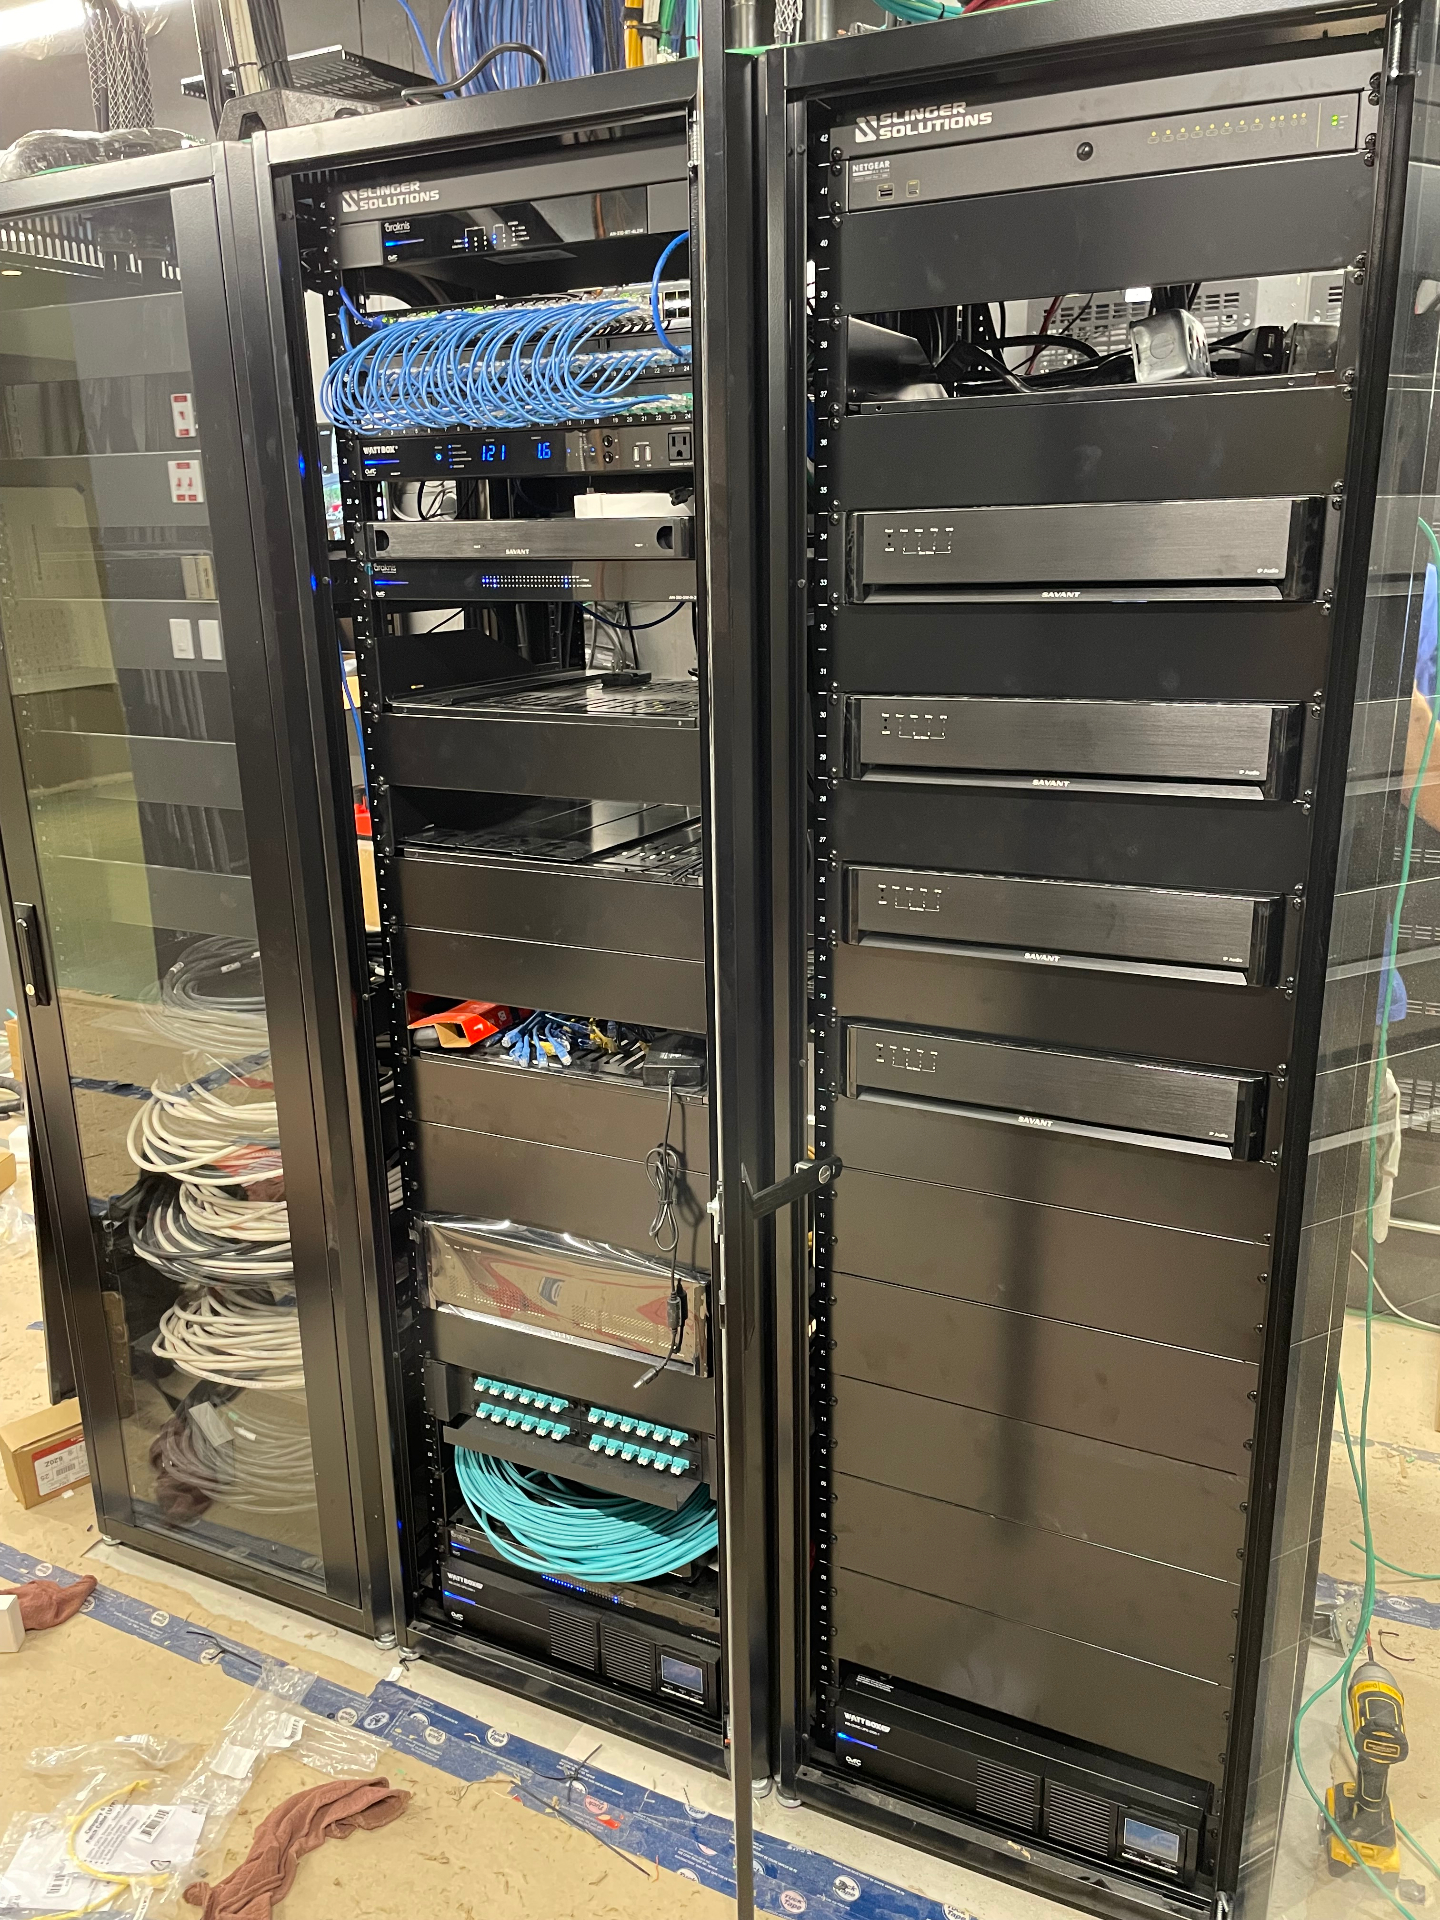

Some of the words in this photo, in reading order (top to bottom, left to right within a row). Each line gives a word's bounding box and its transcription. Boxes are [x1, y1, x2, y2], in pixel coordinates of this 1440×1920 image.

[879, 101, 967, 126] SLINGER
[879, 112, 993, 140] SOLUTIONS
[853, 160, 890, 172] NETGEAR
[359, 181, 420, 199] SLINGER
[359, 190, 440, 211] SOLUTIONS
[481, 445, 506, 461] 121
[1031, 778, 1070, 788] SAVANT
[1023, 952, 1060, 963] SAVANT
[1017, 1115, 1054, 1128] SAVANT
